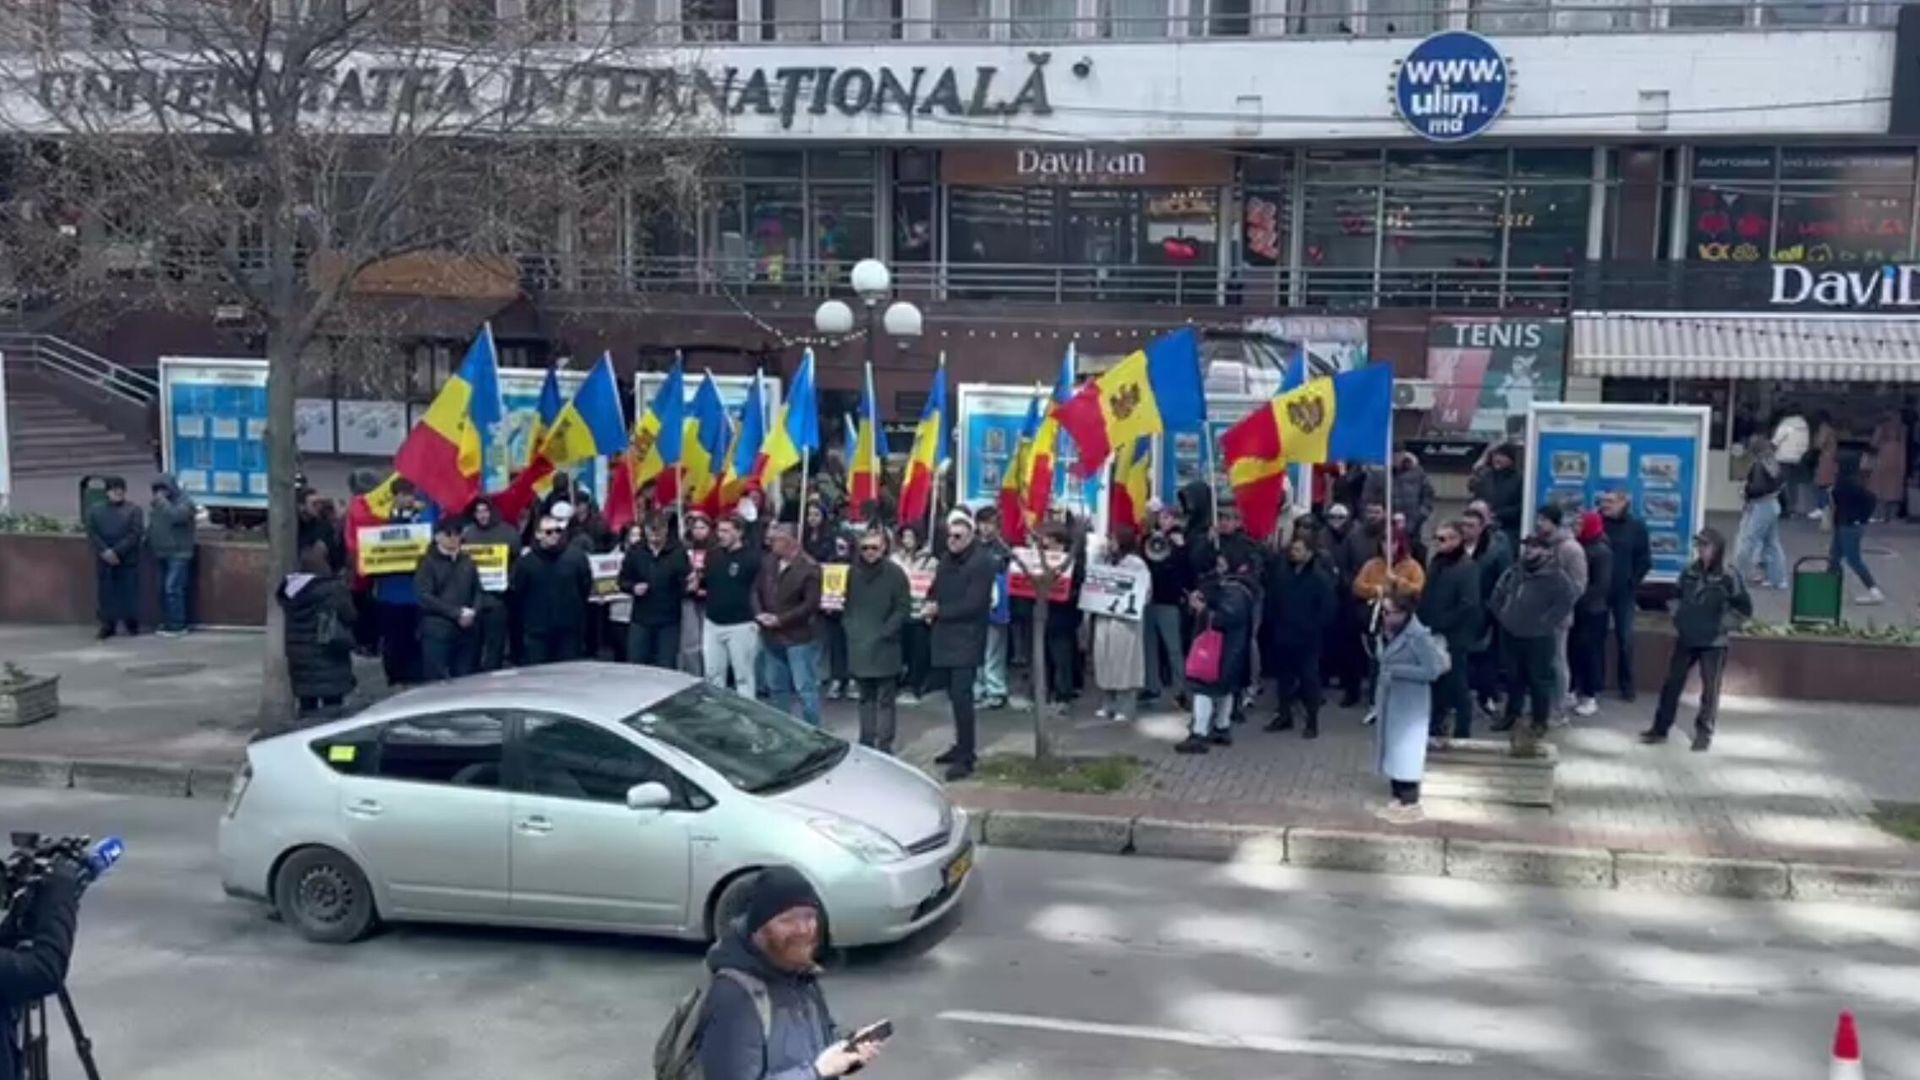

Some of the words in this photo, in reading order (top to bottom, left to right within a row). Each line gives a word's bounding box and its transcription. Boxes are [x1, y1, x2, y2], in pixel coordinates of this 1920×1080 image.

[1406, 58, 1502, 84] www.
[36, 68, 476, 112] UNIVERTATEA
[1411, 84, 1488, 114] ulim.
[1429, 113, 1463, 133] md
[1451, 322, 1542, 348] TENIS
